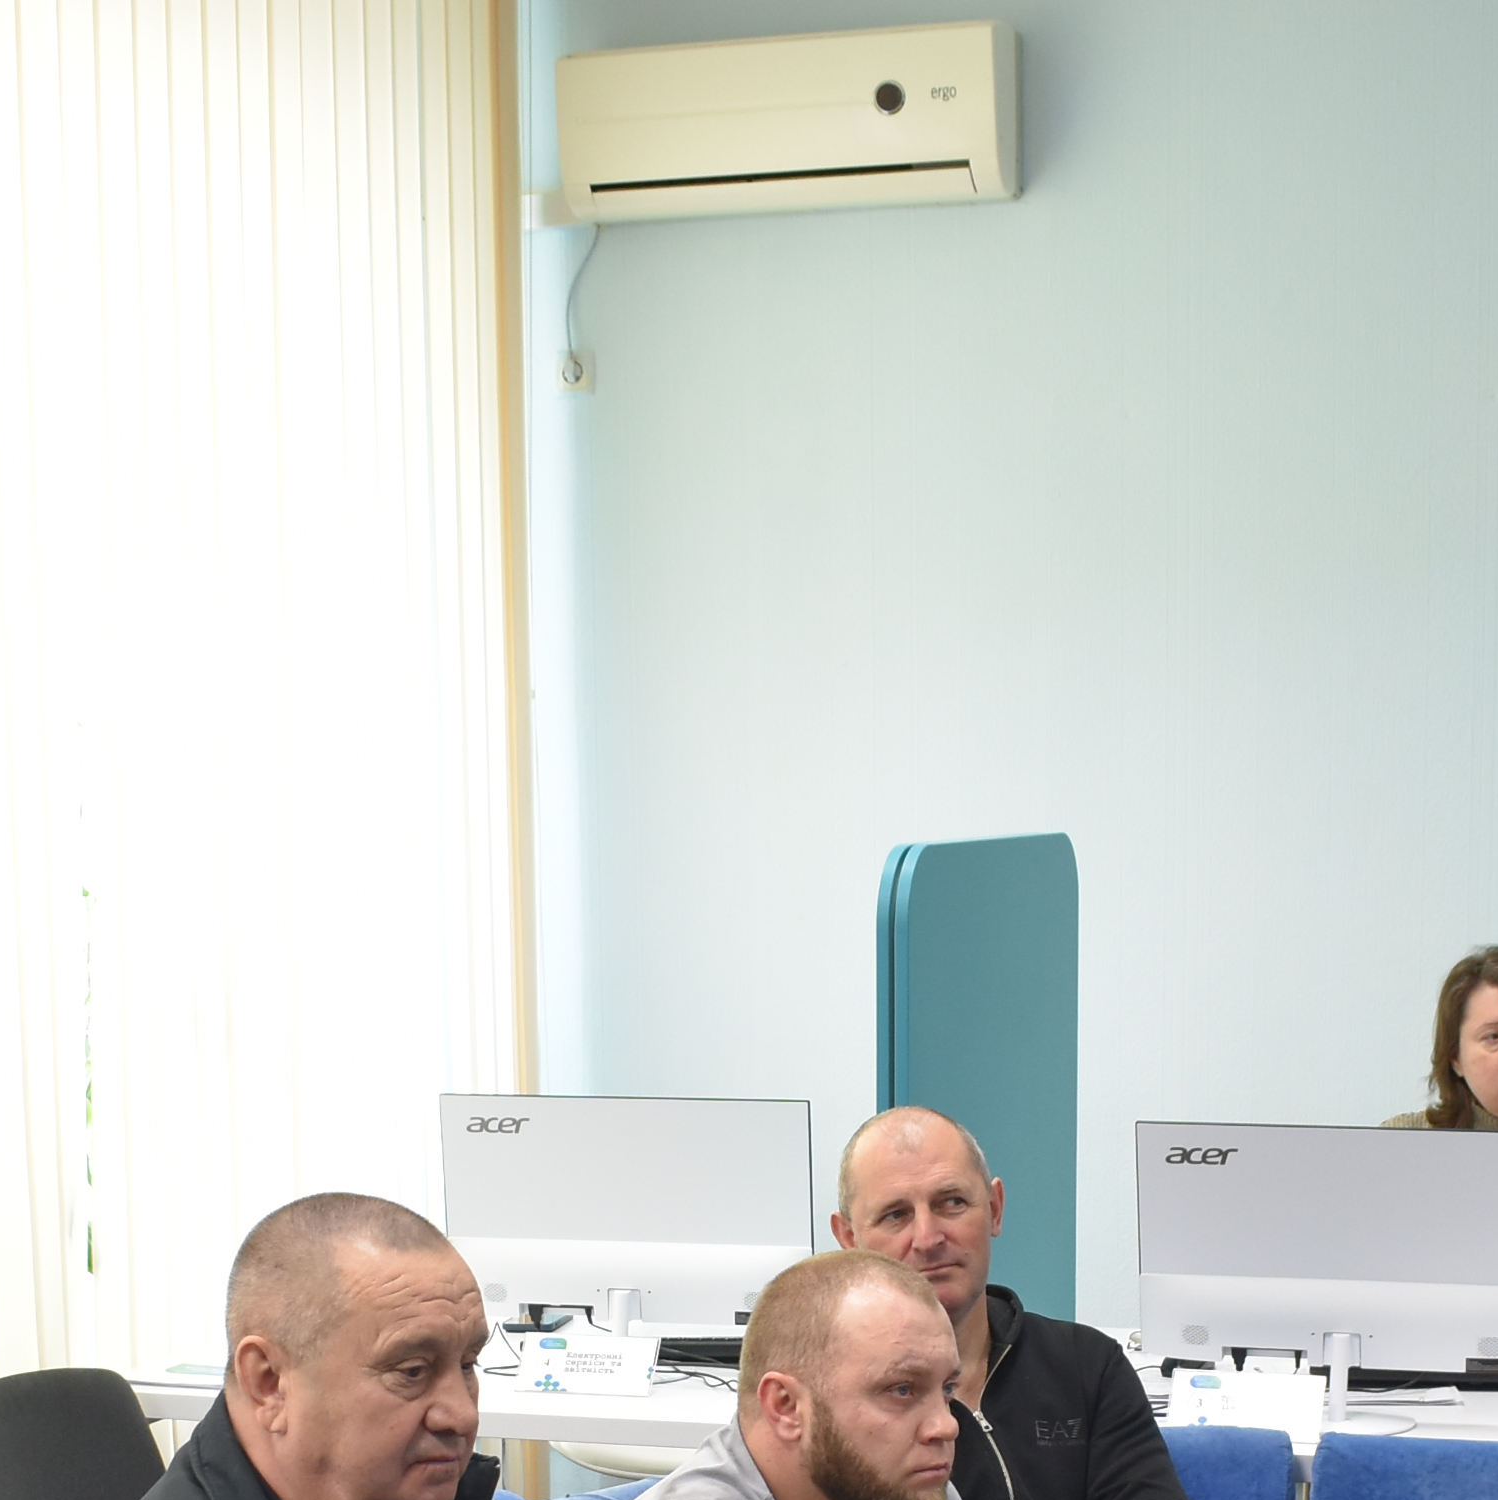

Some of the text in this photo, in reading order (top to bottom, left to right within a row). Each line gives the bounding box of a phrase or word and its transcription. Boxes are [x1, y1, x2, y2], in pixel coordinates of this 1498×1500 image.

[931, 86, 957, 101] ergo
[466, 1116, 530, 1134] acer
[1164, 1146, 1238, 1166] acer
